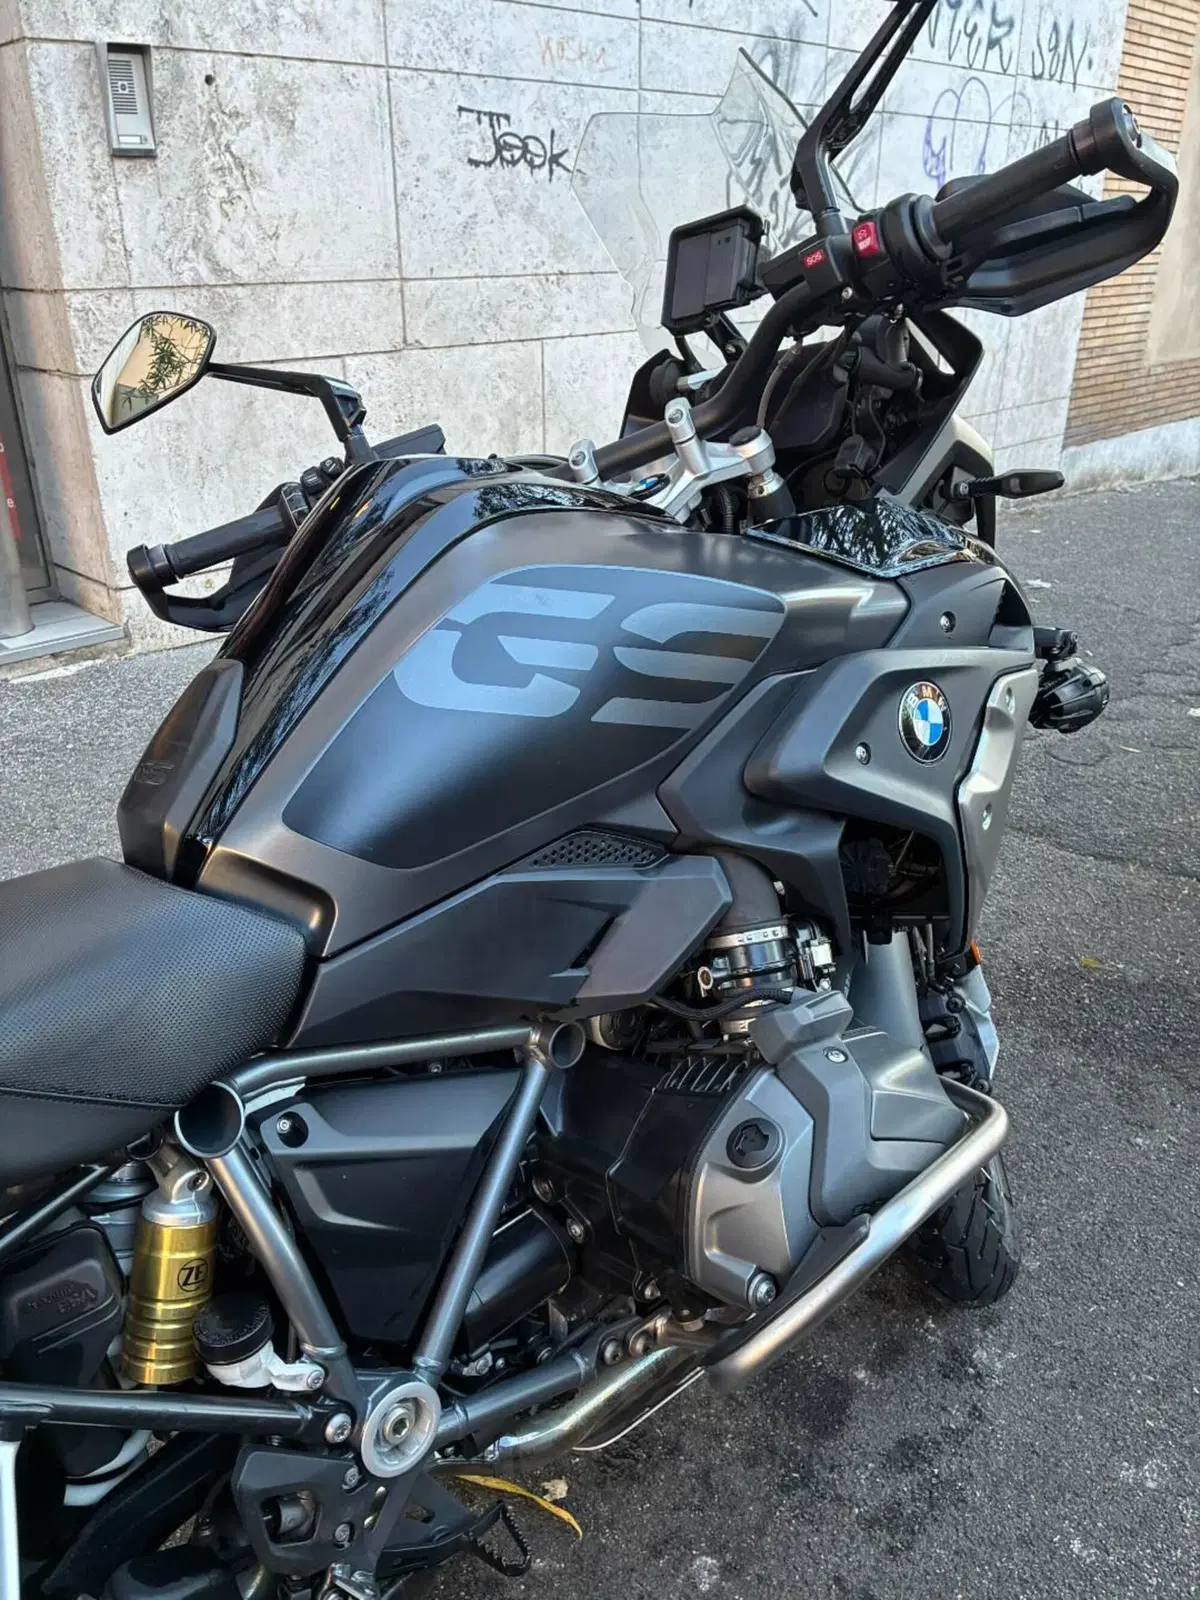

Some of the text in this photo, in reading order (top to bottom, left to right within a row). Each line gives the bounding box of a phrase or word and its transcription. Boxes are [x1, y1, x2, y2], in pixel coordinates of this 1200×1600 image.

[806, 250, 823, 266] SOS
[393, 583, 786, 731] GS
[906, 685, 948, 712] BMW
[181, 1262, 207, 1287] ZF
